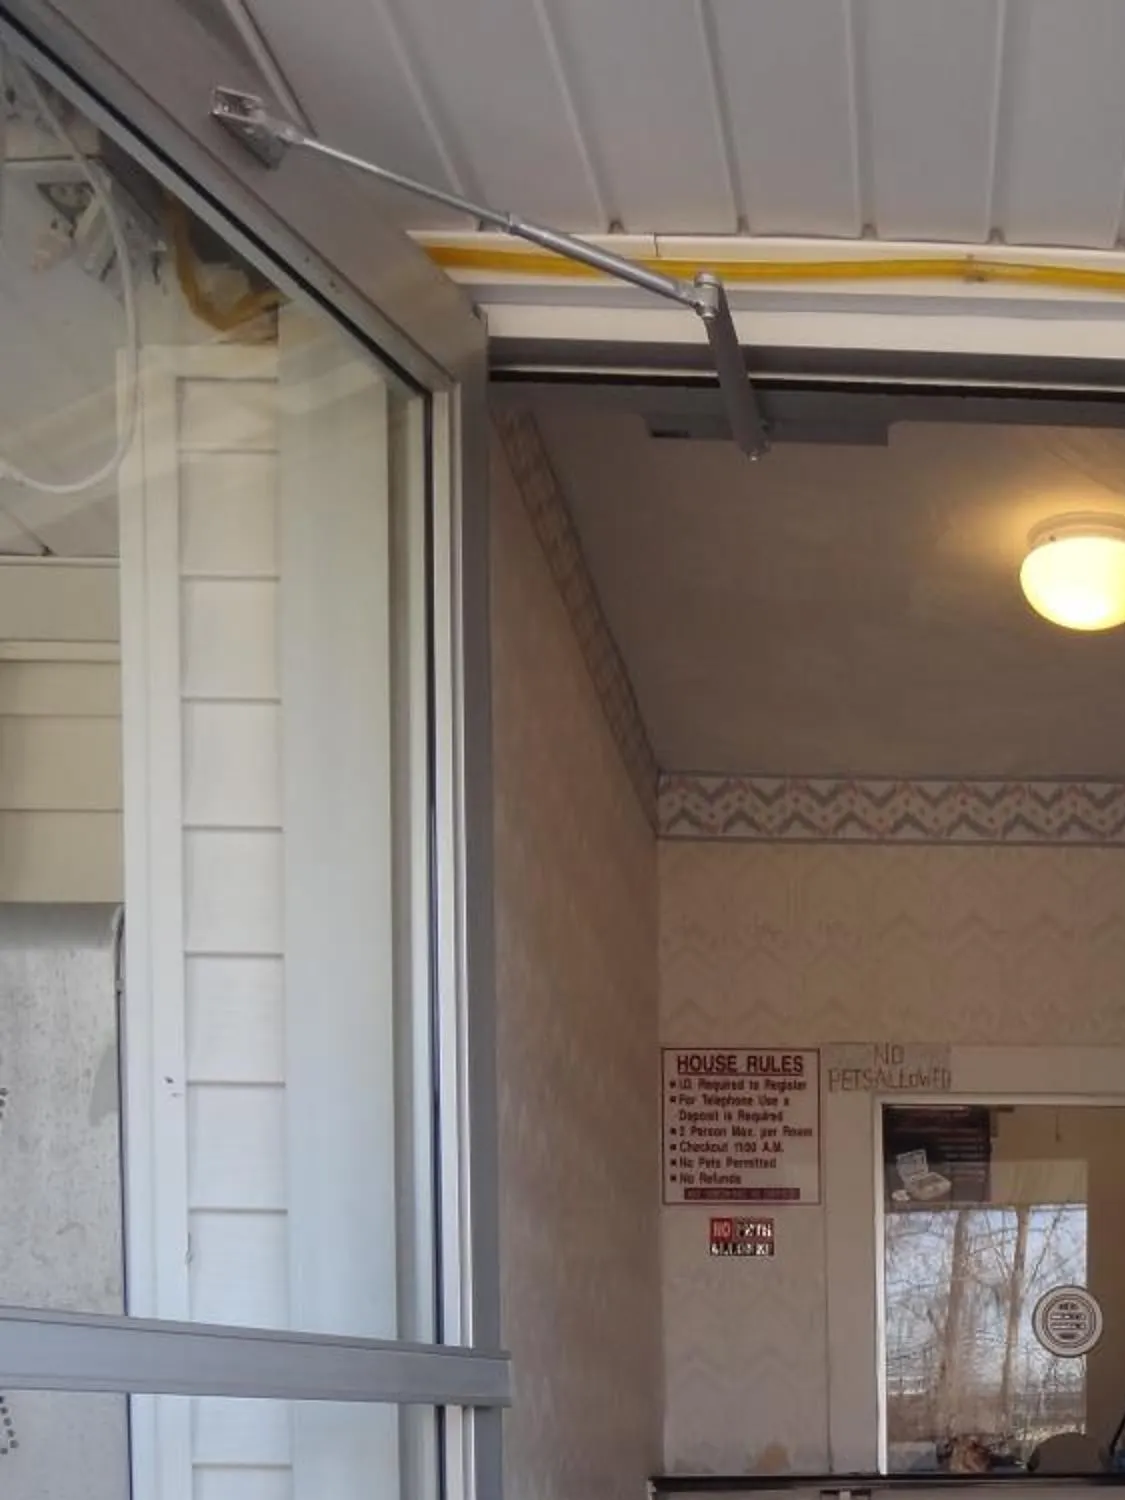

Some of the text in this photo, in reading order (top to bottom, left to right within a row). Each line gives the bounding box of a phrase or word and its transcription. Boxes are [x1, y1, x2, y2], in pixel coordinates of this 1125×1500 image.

[873, 1042, 905, 1065] NO
[677, 1055, 804, 1073] HOUSE RULES
[698, 1078, 745, 1092] Required
[749, 1079, 759, 1091] to
[765, 1078, 807, 1093] Register
[827, 1067, 876, 1092] PETS
[678, 1094, 790, 1108] For Telephone Use a
[679, 1110, 783, 1123] Deposit is Required
[690, 1126, 727, 1137] Person
[760, 1128, 777, 1140] per
[782, 1126, 813, 1137] Room
[679, 1141, 728, 1153] Checkout
[679, 1156, 777, 1169] No Pets Permitted
[679, 1171, 742, 1184] No Refunds
